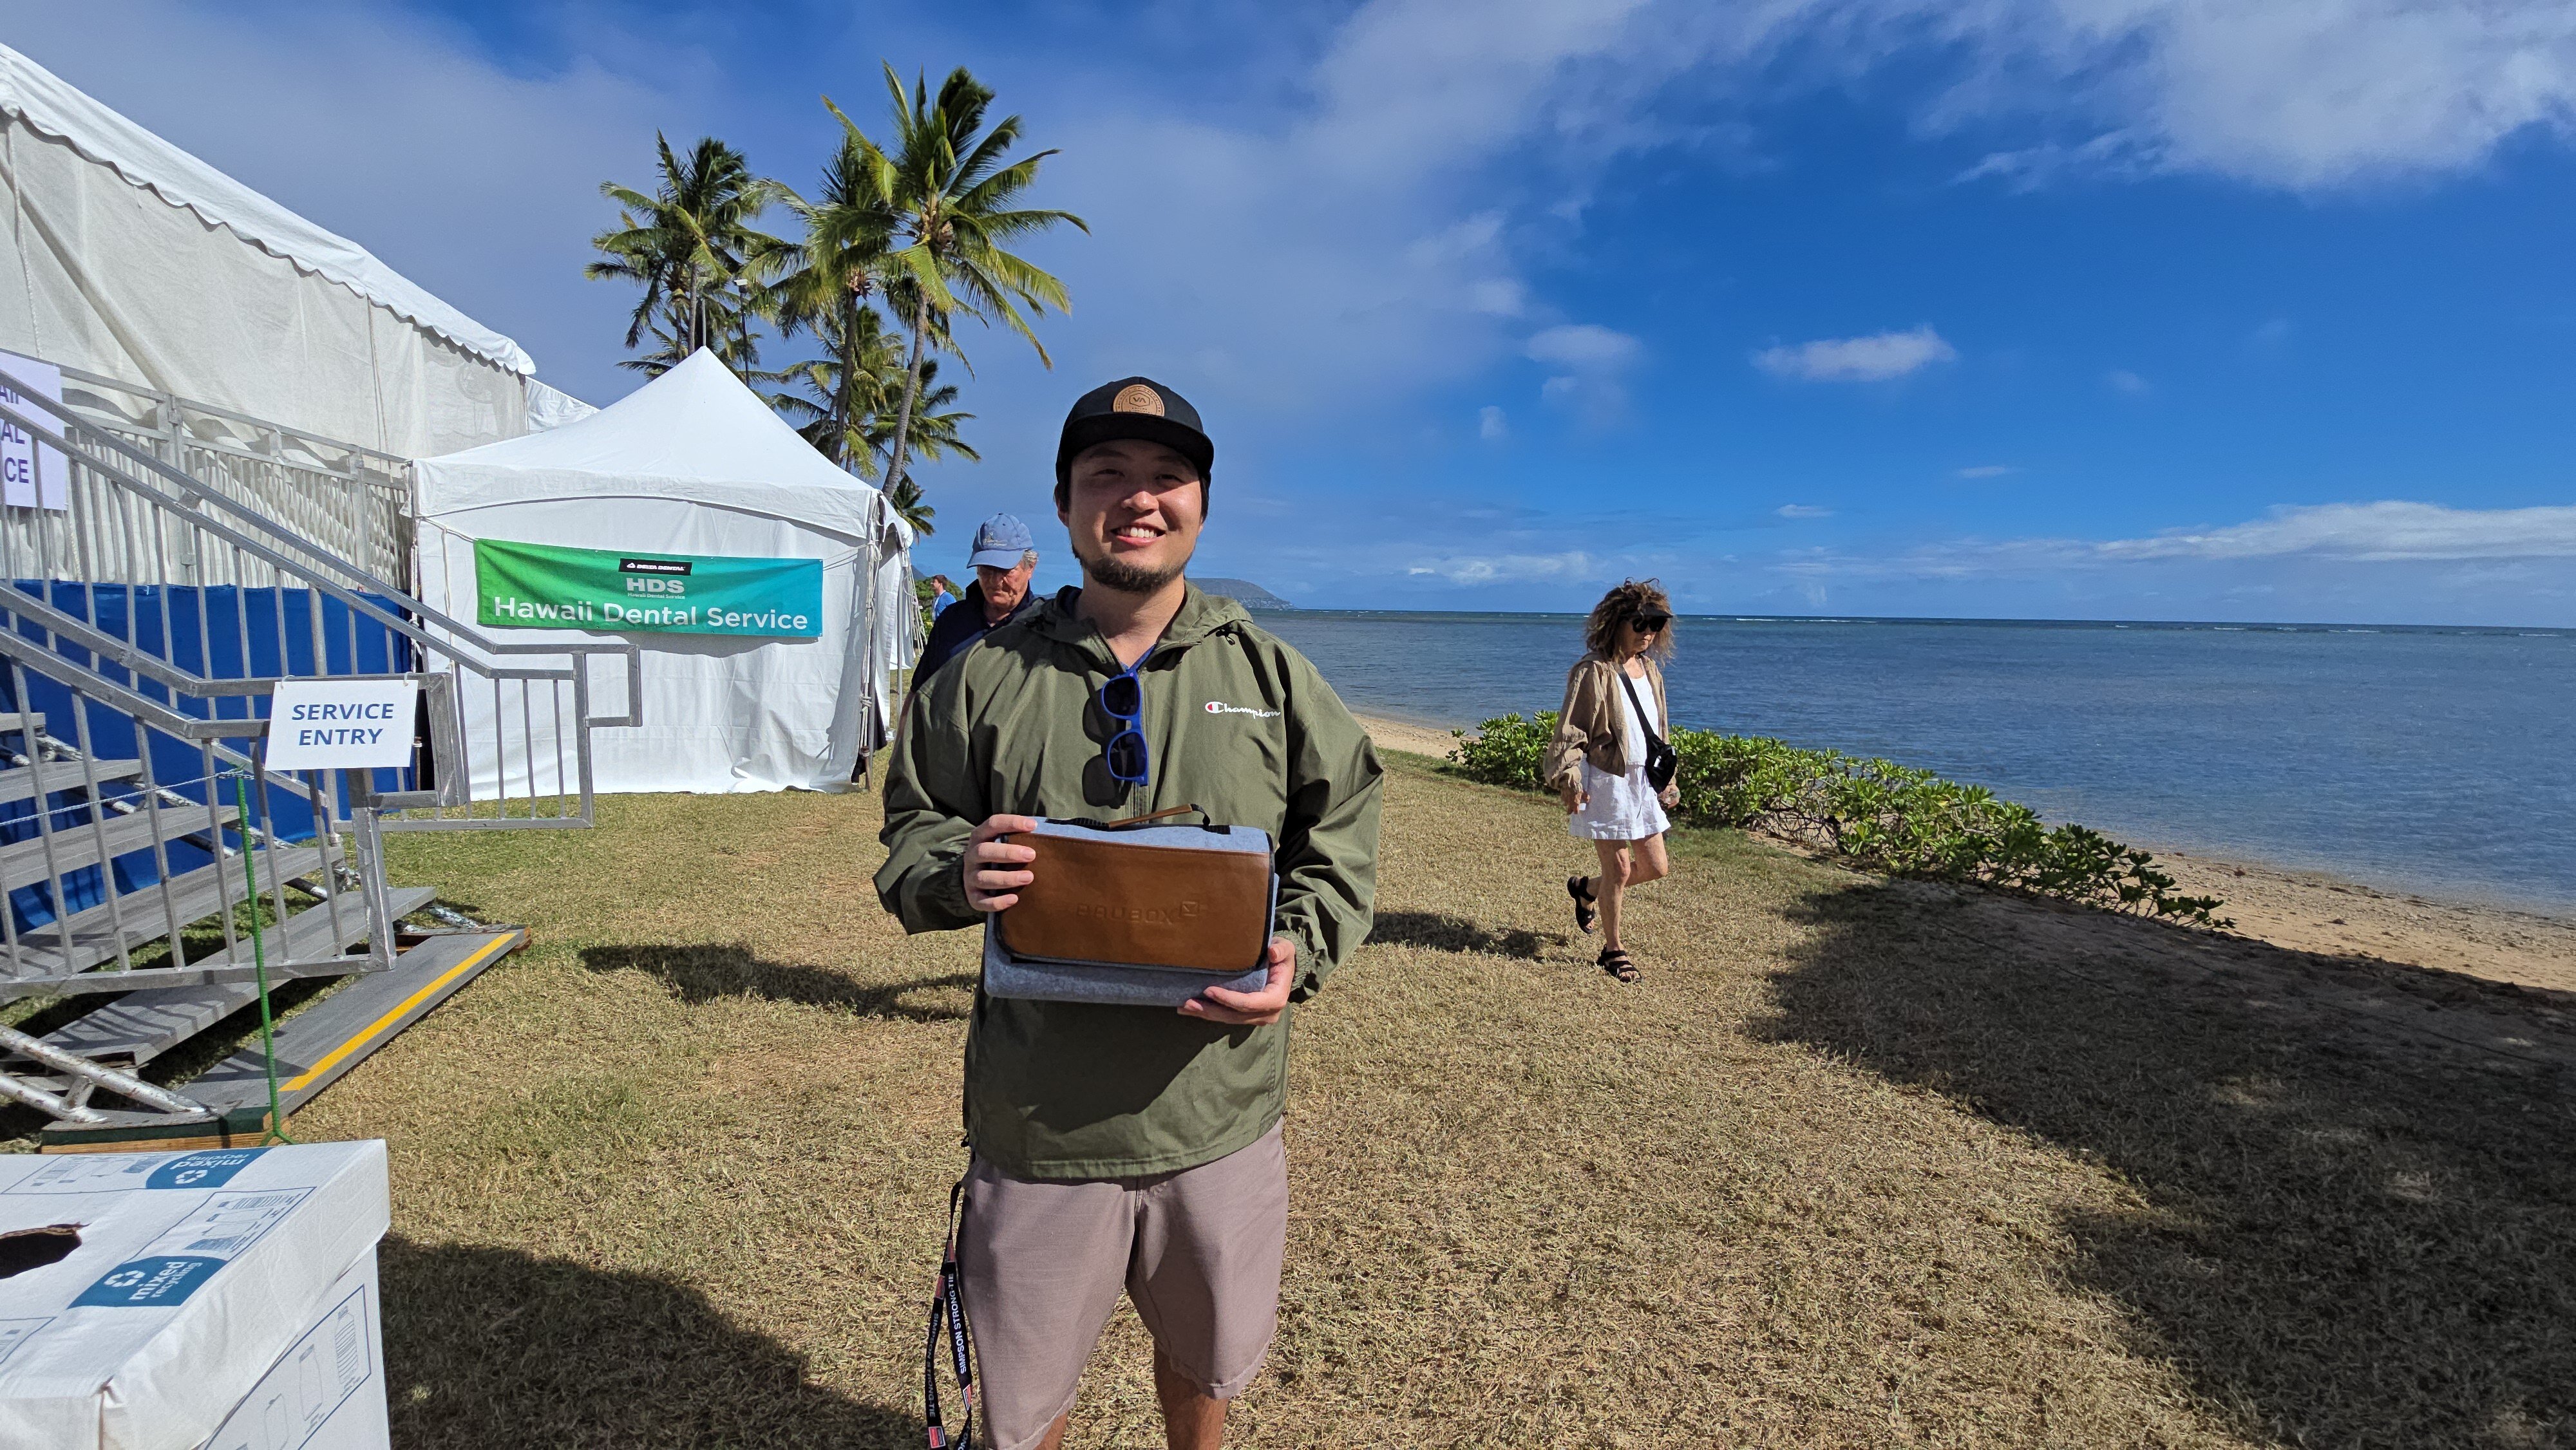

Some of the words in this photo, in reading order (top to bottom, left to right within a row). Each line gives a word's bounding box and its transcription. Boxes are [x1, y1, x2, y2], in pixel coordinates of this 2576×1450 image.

[626, 578, 685, 594] HDS
[494, 596, 592, 622] Hawaii
[604, 603, 697, 626] Dental
[708, 607, 808, 630] Service
[291, 702, 395, 720] SERVICE
[1204, 701, 1281, 719] Champion
[299, 728, 384, 746] ENTRY
[169, 1158, 245, 1170] mixed
[128, 1261, 189, 1301] mixed
[149, 1261, 204, 1298] recycling
[947, 1273, 961, 1330] STRONG-TIE
[955, 1331, 967, 1375] SIMPSON
